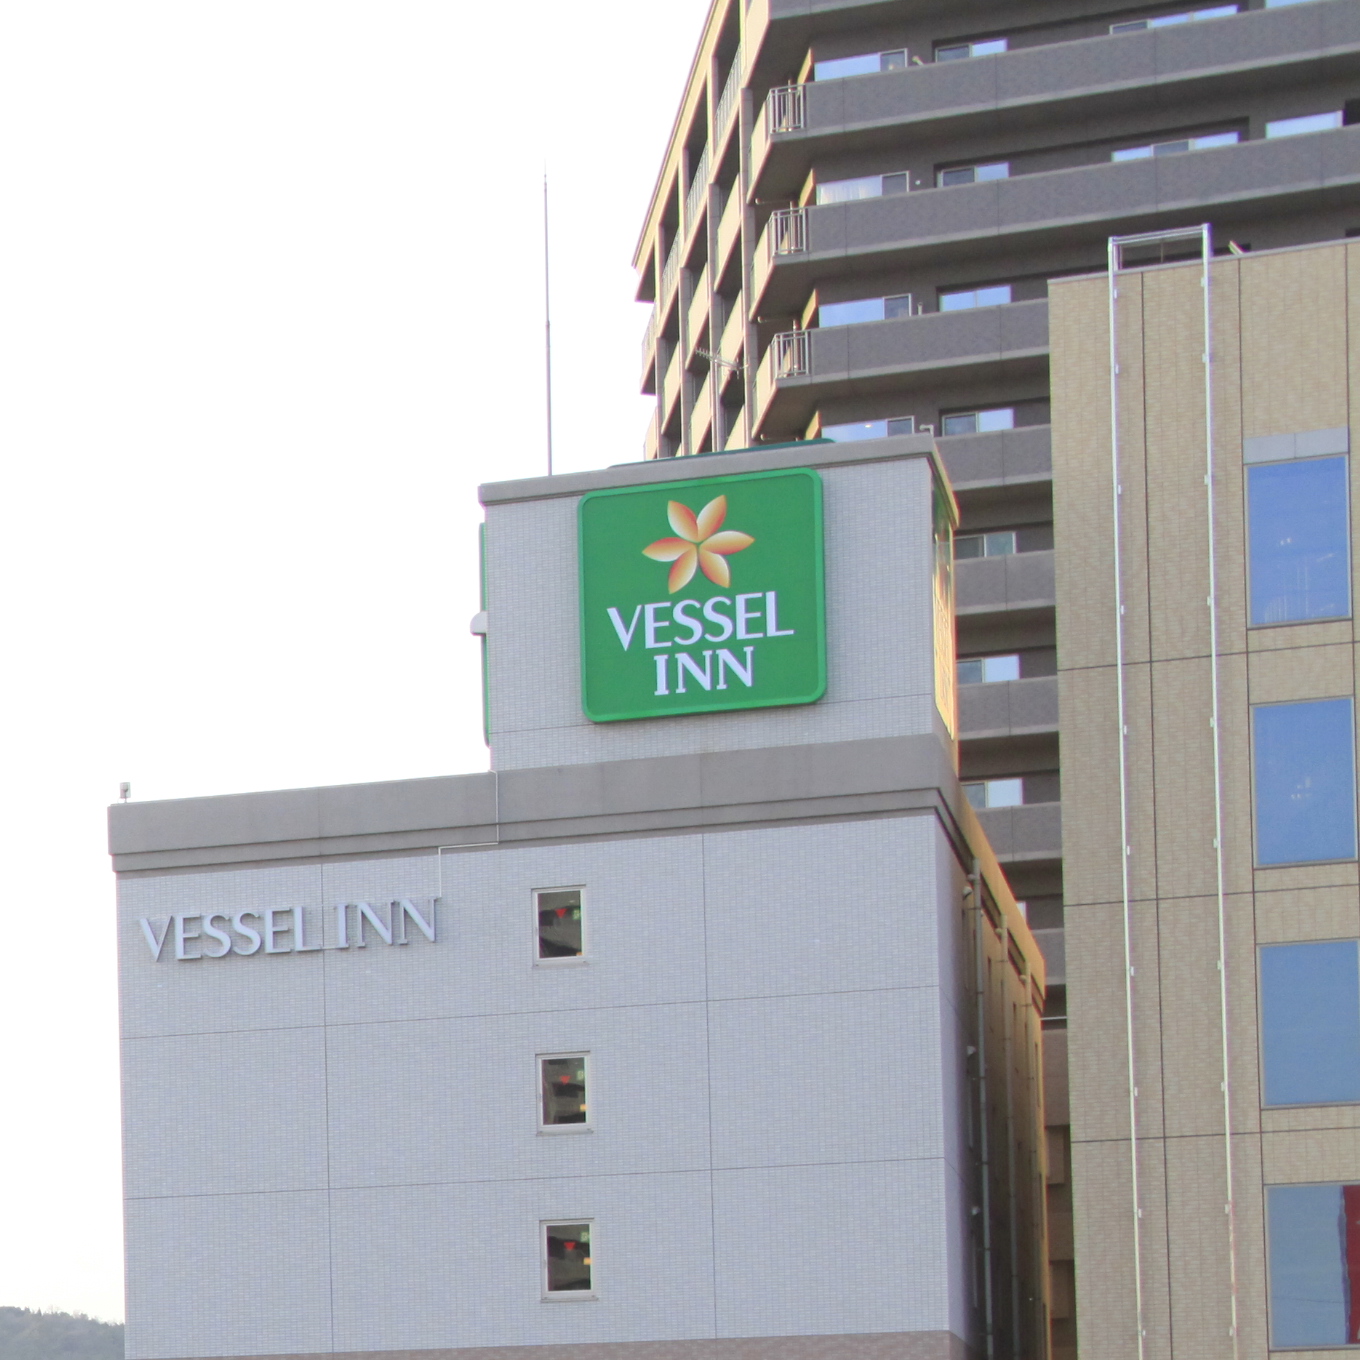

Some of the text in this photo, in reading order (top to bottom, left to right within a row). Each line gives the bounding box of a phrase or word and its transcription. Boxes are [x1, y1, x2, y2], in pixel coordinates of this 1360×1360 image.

[607, 591, 794, 651] VESSEL
[654, 646, 755, 696] INN
[140, 897, 441, 962] VESSEL INN
